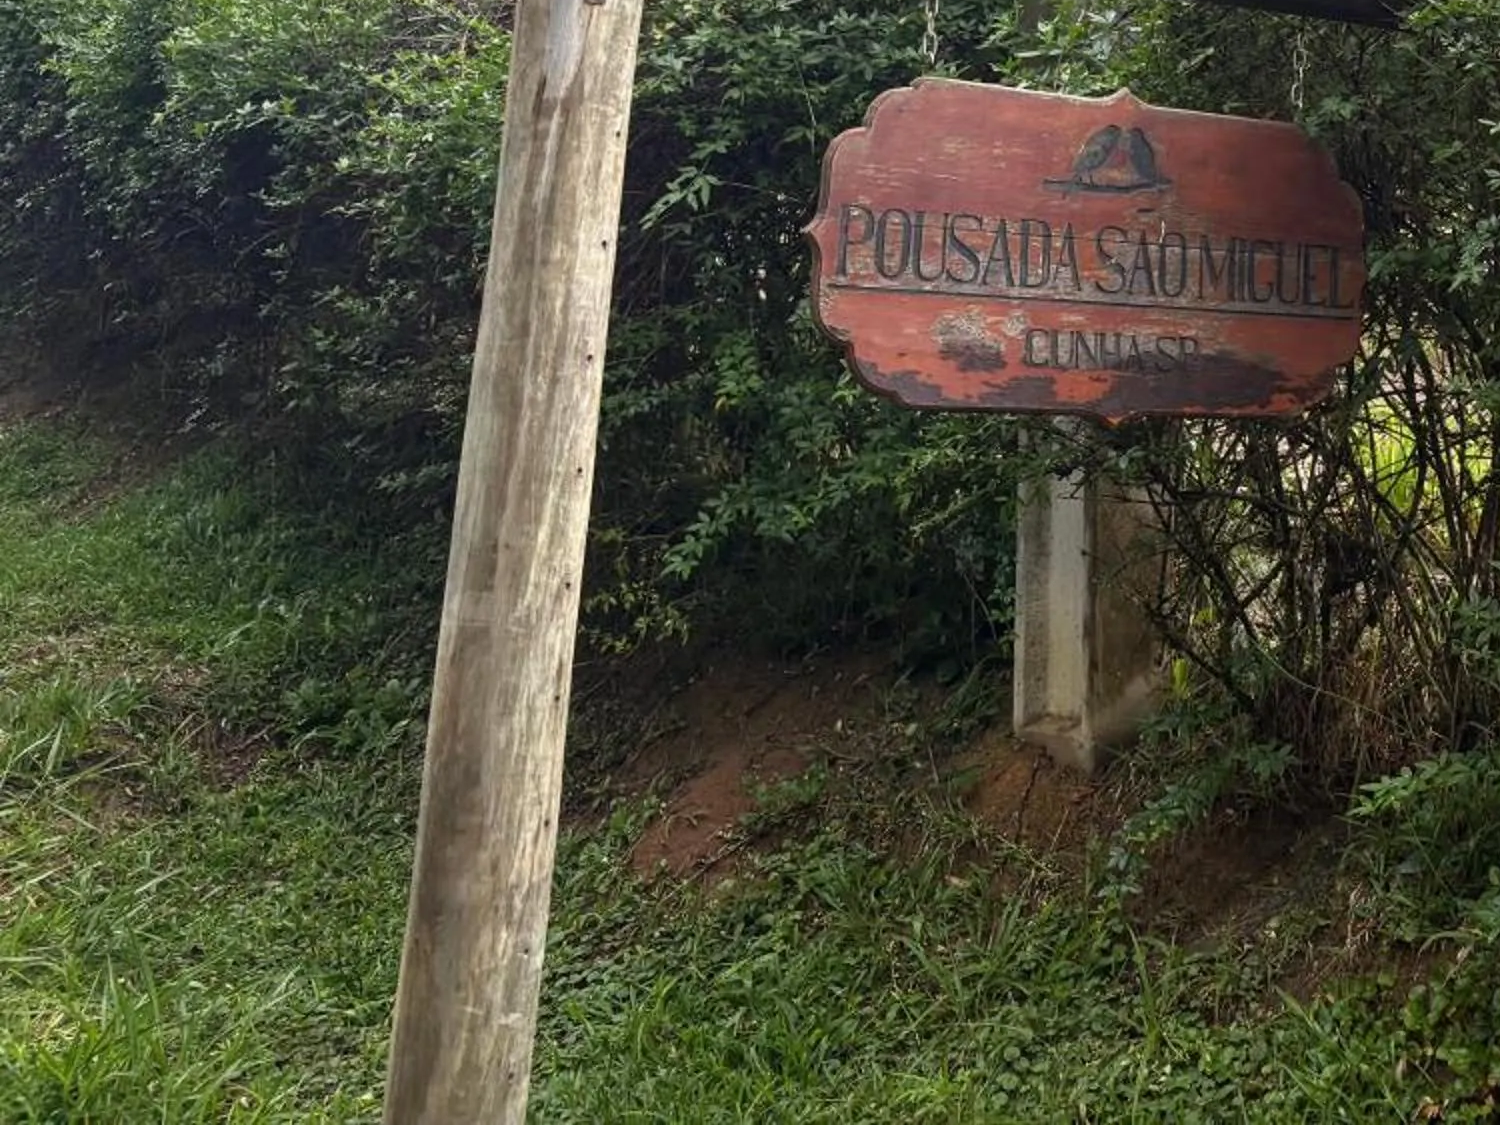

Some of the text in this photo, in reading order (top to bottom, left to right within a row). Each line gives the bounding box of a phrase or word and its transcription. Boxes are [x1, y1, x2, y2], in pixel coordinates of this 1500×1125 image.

[836, 204, 1355, 309] POUSADA SÃO MIGUEL
